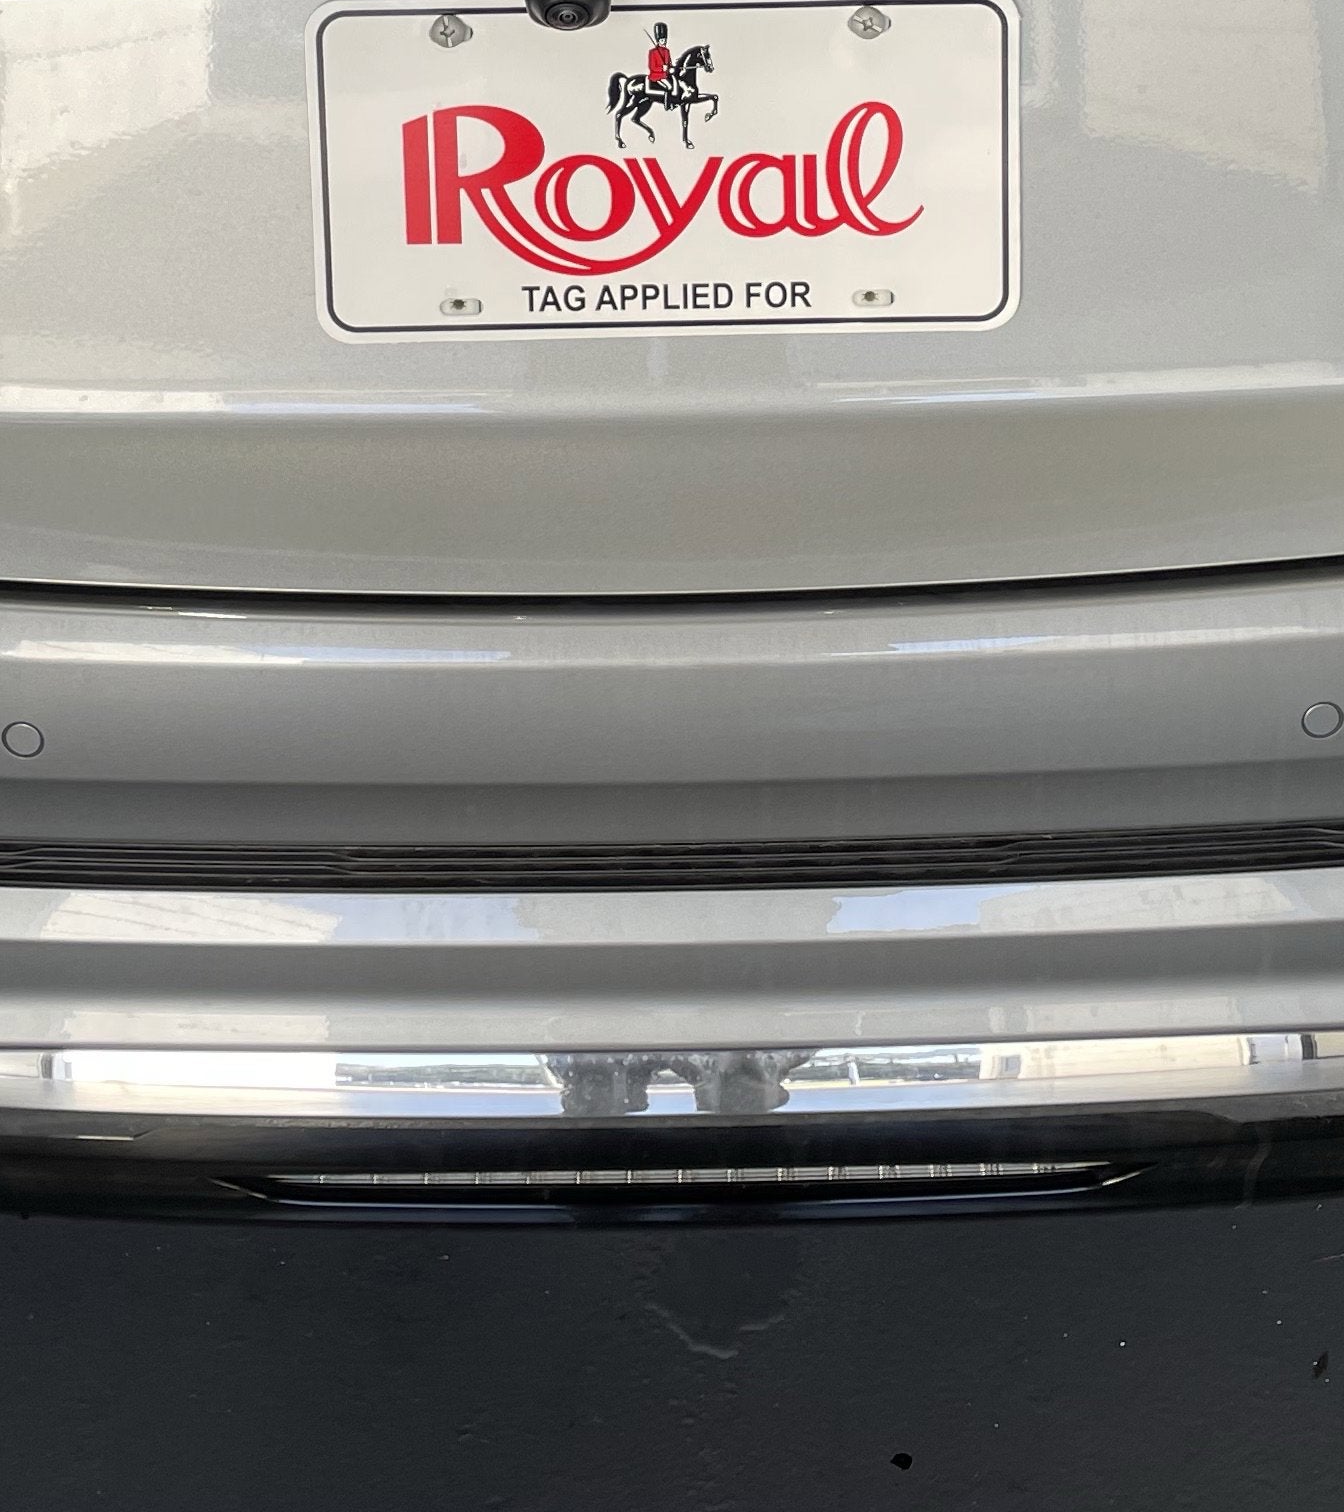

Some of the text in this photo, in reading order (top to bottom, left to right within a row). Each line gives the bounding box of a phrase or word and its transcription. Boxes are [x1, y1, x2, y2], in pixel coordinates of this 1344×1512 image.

[402, 101, 924, 276] Royal
[521, 281, 812, 312] TAG APPLIED FOR
